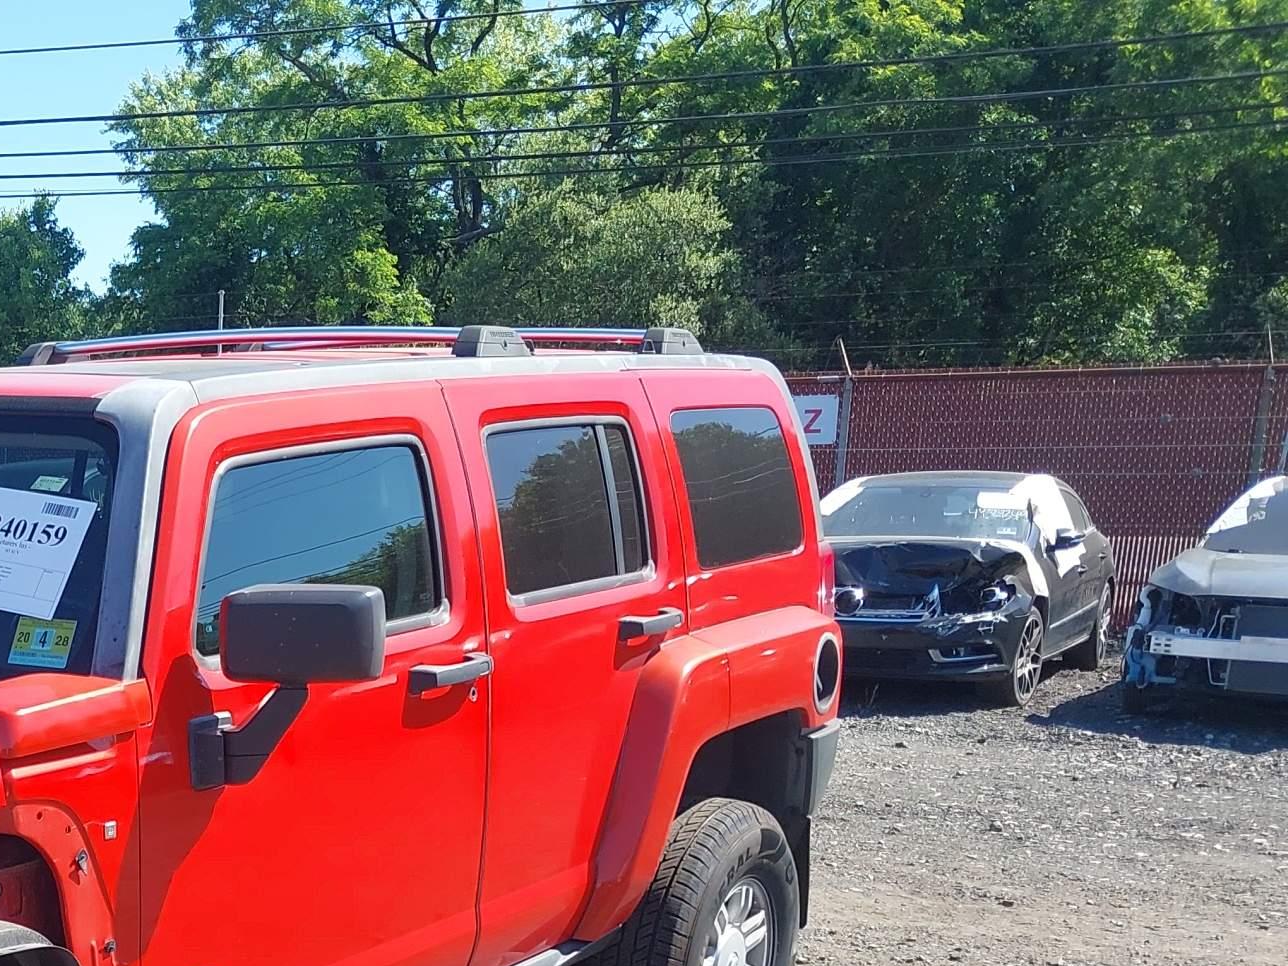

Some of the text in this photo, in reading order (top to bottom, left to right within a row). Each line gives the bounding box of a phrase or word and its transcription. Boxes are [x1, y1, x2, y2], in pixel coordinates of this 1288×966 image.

[17, 630, 70, 649] 20 4 28
